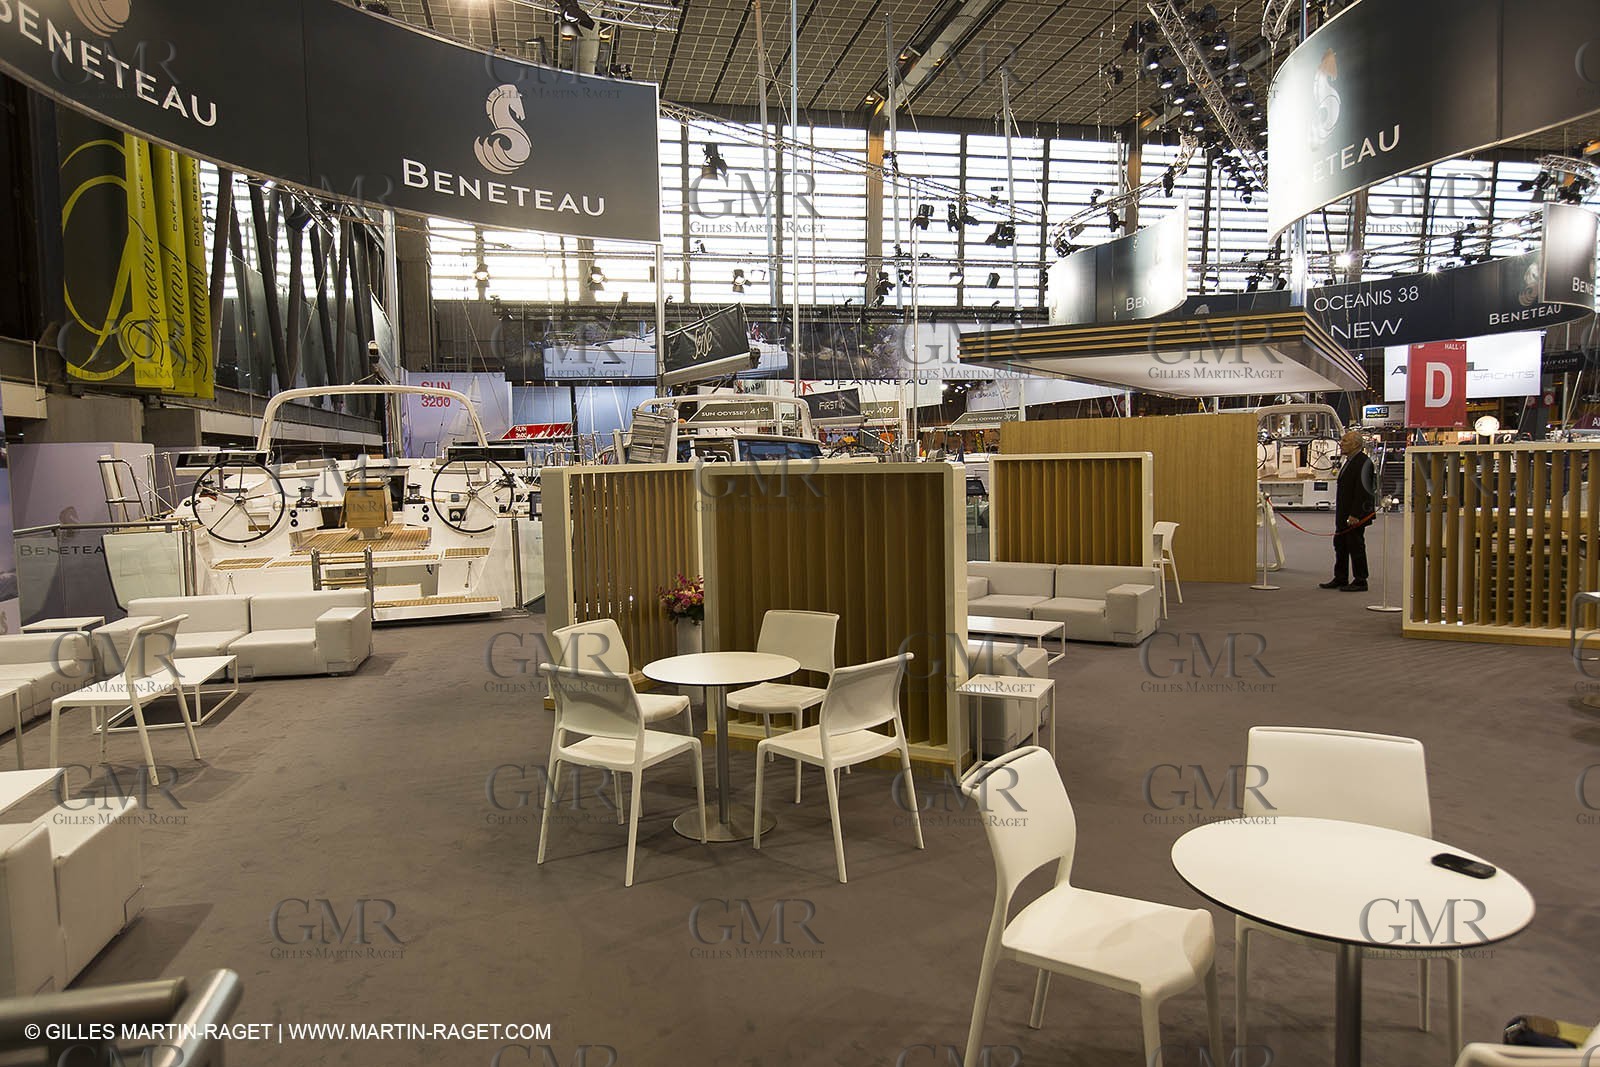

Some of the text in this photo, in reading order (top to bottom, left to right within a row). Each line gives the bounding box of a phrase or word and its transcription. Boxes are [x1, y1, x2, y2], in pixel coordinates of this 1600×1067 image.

[402, 158, 605, 217] BENETEAU
[1313, 286, 1419, 312] OCEANIS 38
[1489, 304, 1562, 326] BENETEAU
[1331, 318, 1402, 340] NEW
[1425, 362, 1452, 408] D
